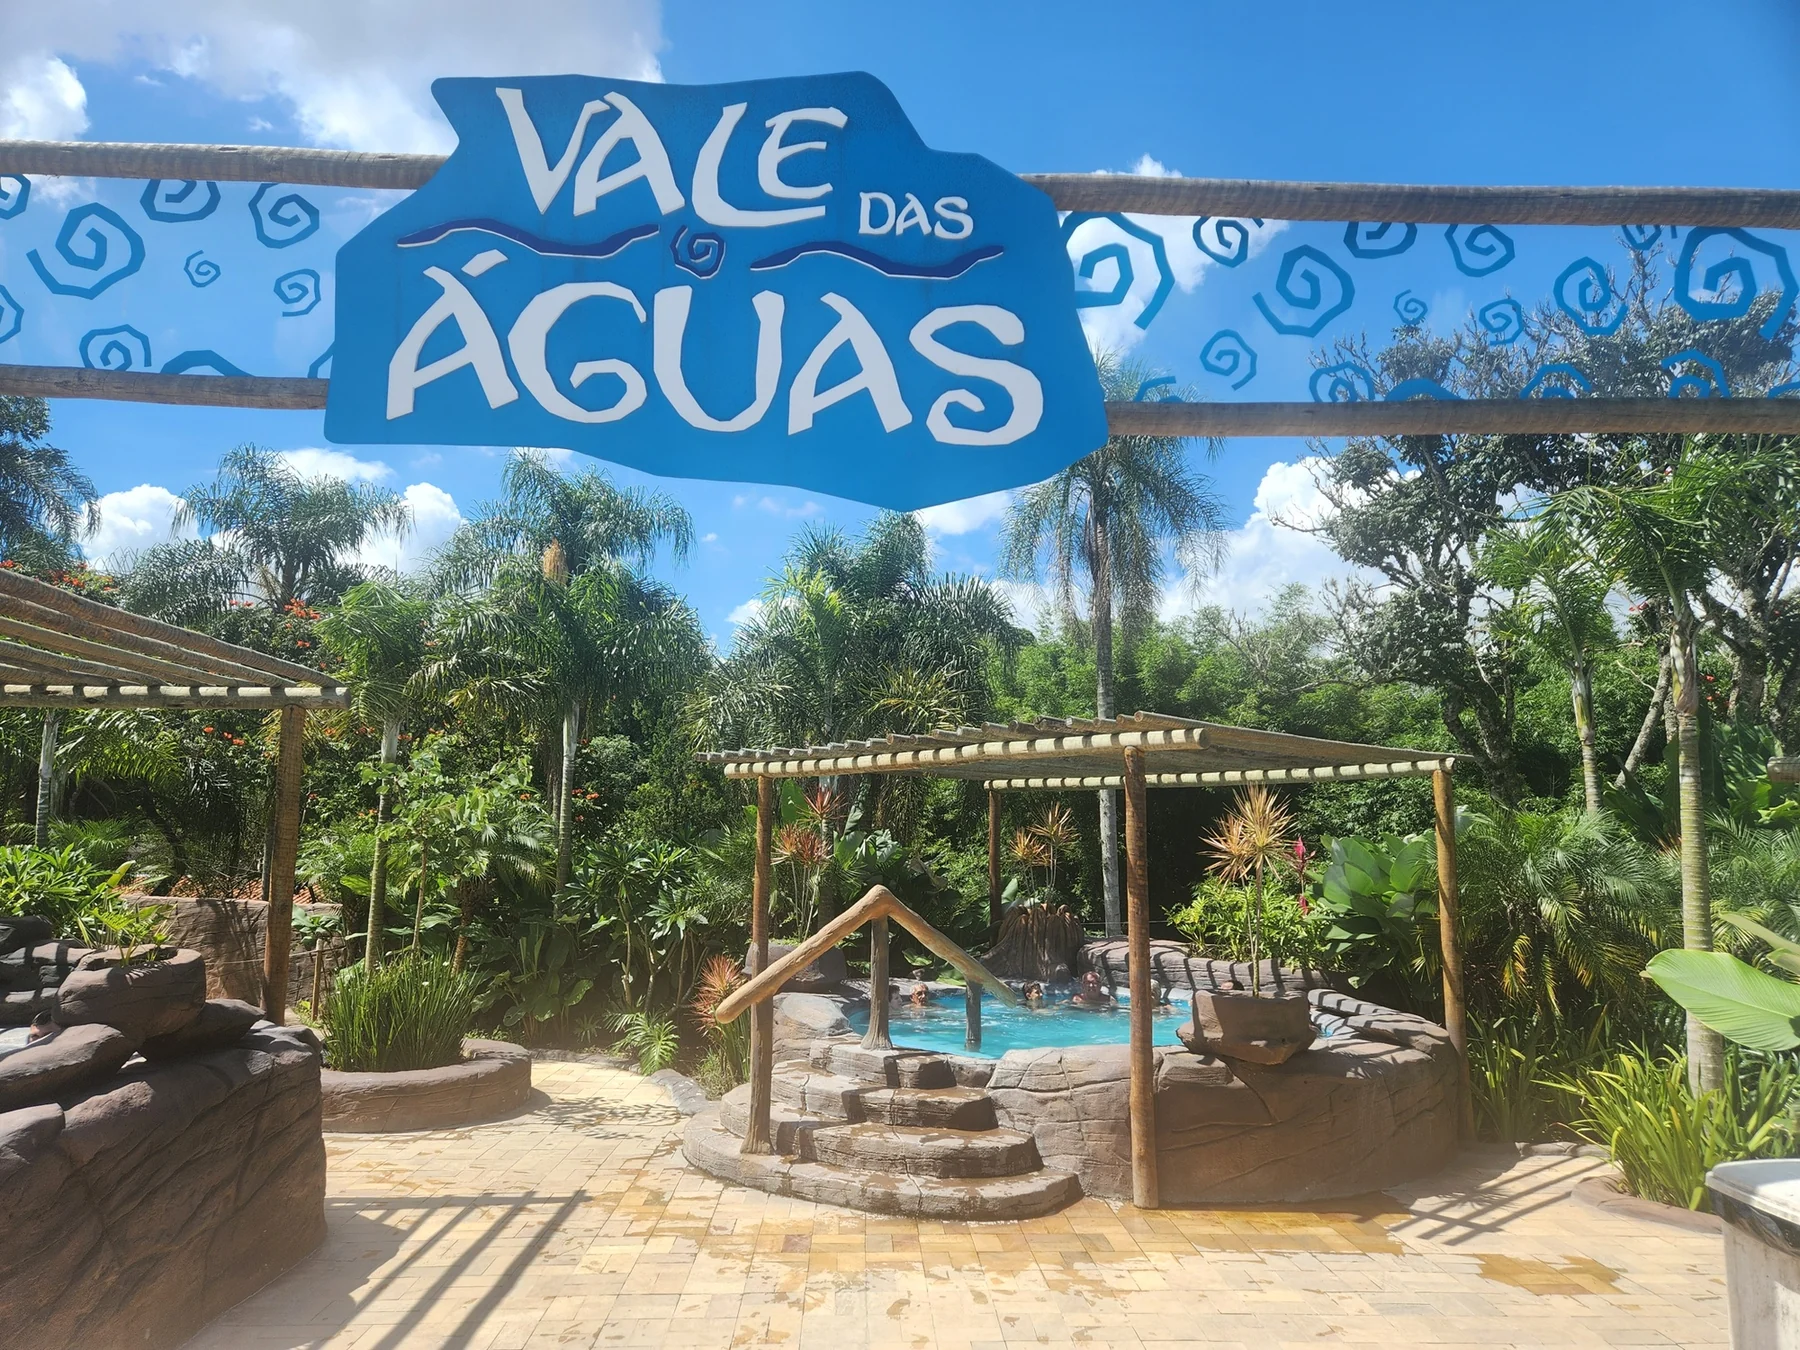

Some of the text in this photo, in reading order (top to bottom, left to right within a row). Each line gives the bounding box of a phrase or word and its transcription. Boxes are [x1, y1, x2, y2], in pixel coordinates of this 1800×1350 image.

[495, 87, 973, 240] VALE DAS
[386, 249, 1044, 446] ÁGUAS
